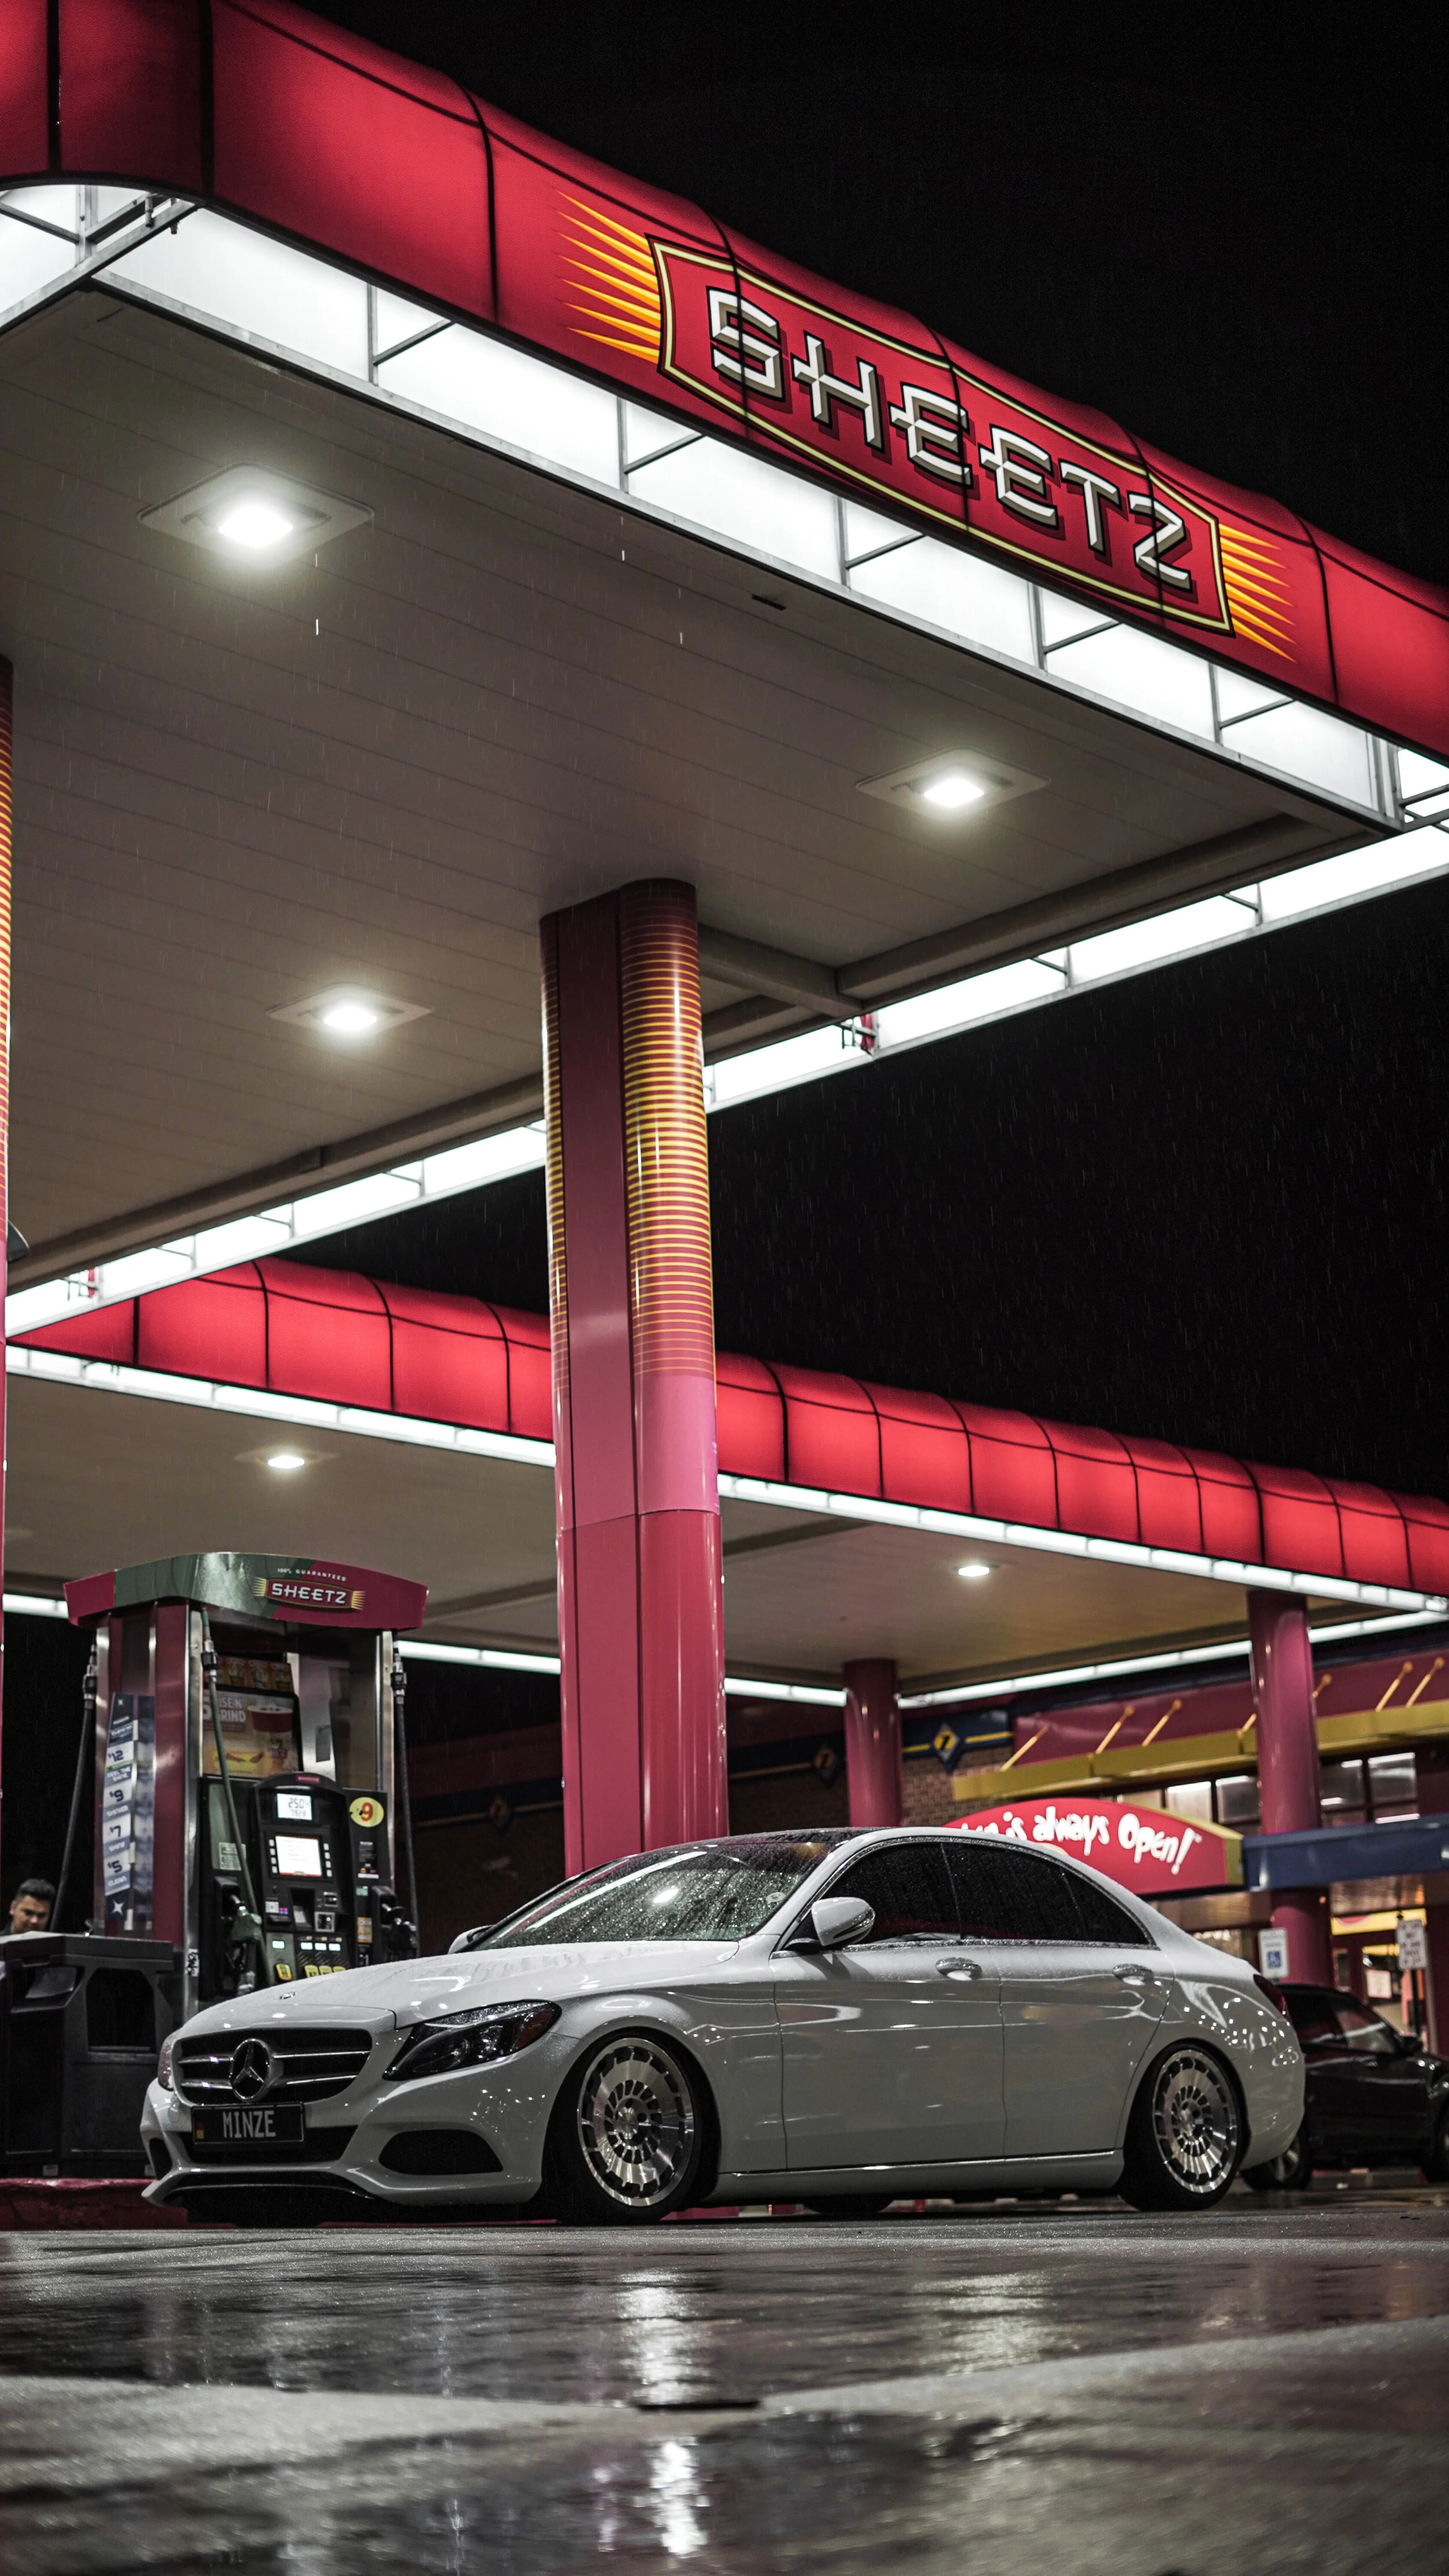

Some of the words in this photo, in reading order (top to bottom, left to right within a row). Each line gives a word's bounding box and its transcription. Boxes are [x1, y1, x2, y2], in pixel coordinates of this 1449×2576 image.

[706, 286, 1192, 592] SHEETZ
[295, 1568, 347, 1582] GUARANTEED
[272, 1582, 347, 1604] SHEETZ
[219, 1709, 246, 1723] RIND
[361, 1801, 374, 1822] 9
[1032, 1805, 1110, 1856] always
[1118, 1813, 1196, 1875] Open!
[223, 2110, 276, 2138] MINZE
